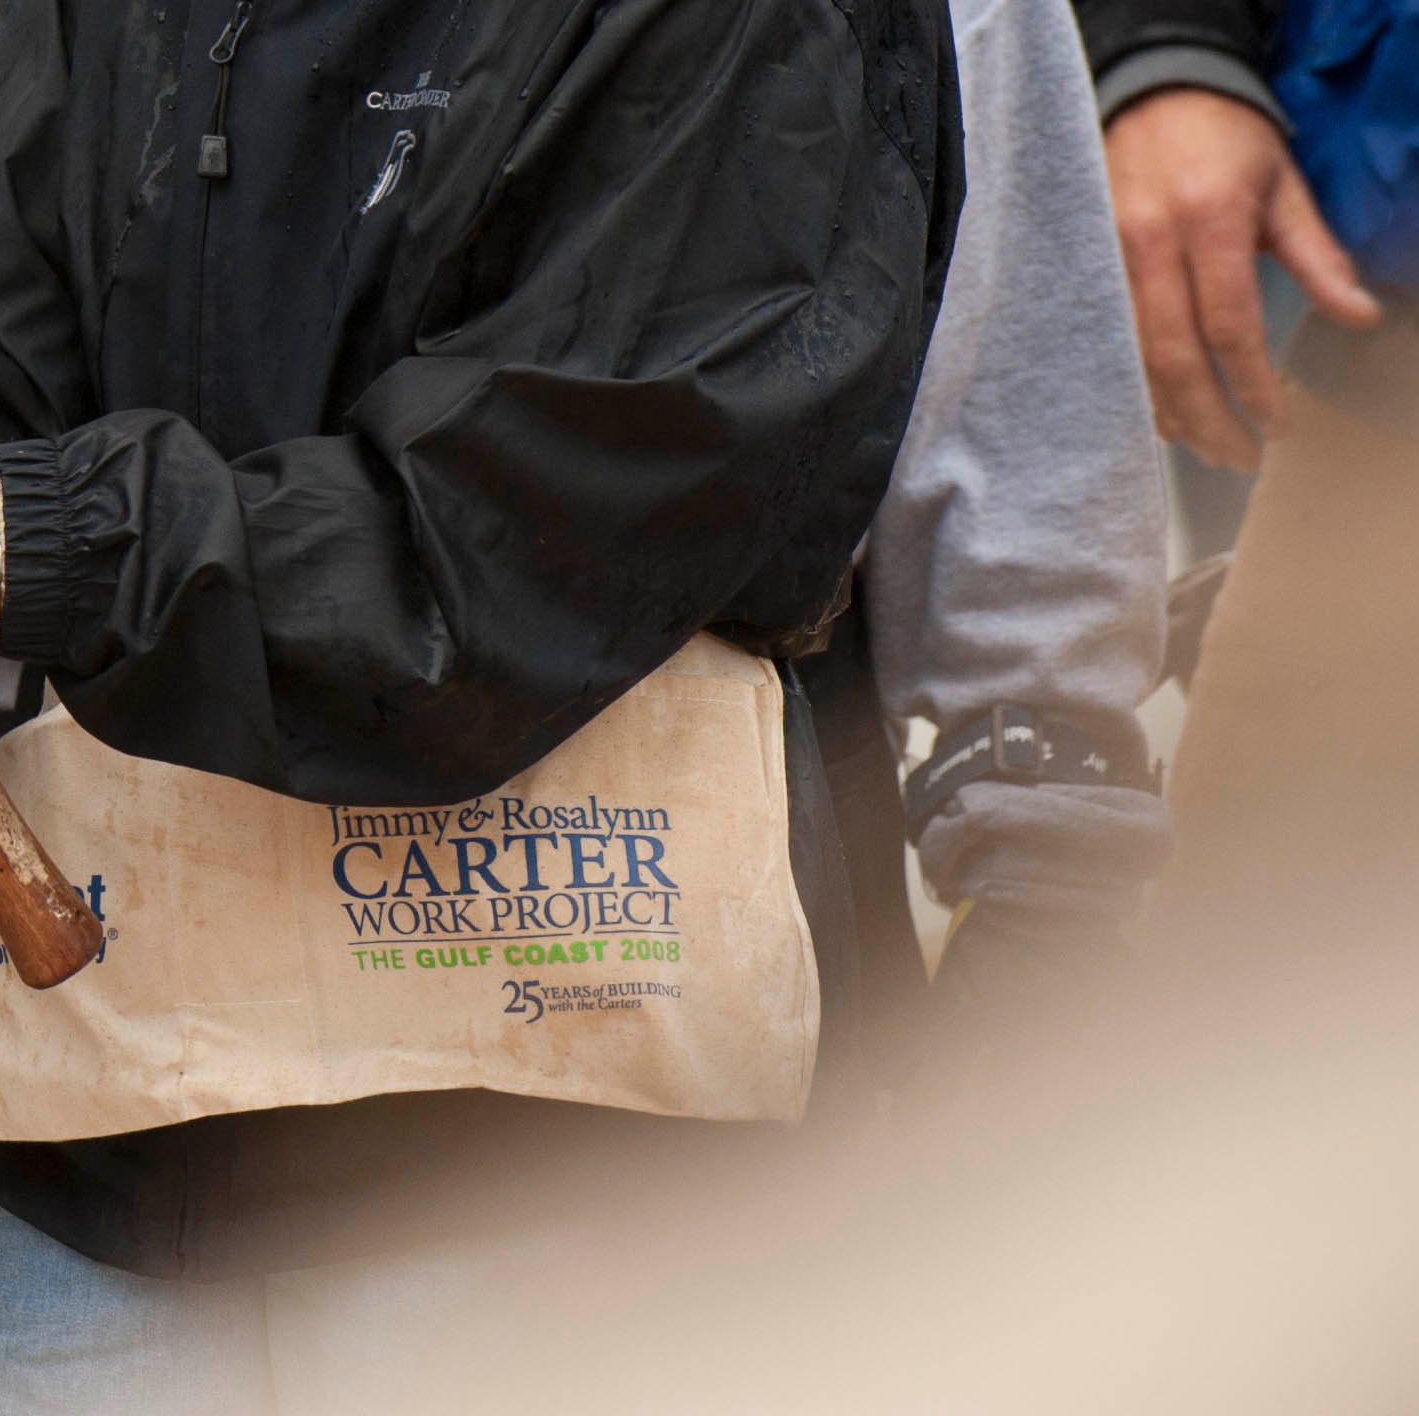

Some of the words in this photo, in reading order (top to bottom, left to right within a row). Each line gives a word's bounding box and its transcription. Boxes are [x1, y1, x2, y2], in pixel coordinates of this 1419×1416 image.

[327, 806, 452, 847] Jimmy
[458, 798, 494, 833] &
[499, 795, 672, 841] Rosalynn
[333, 832, 679, 900] CARTER
[341, 898, 482, 937] WORK
[487, 890, 681, 934] PROJECT
[351, 949, 406, 971] THE
[415, 945, 492, 969] GULF
[504, 940, 608, 966] COAST
[620, 938, 681, 963] 2008
[501, 980, 544, 1024] 25
[541, 985, 591, 999] YEARS
[592, 985, 605, 999] of
[607, 981, 681, 999] BUILDING
[548, 1000, 574, 1012] with
[577, 998, 594, 1011] the
[597, 997, 642, 1012] Carters
